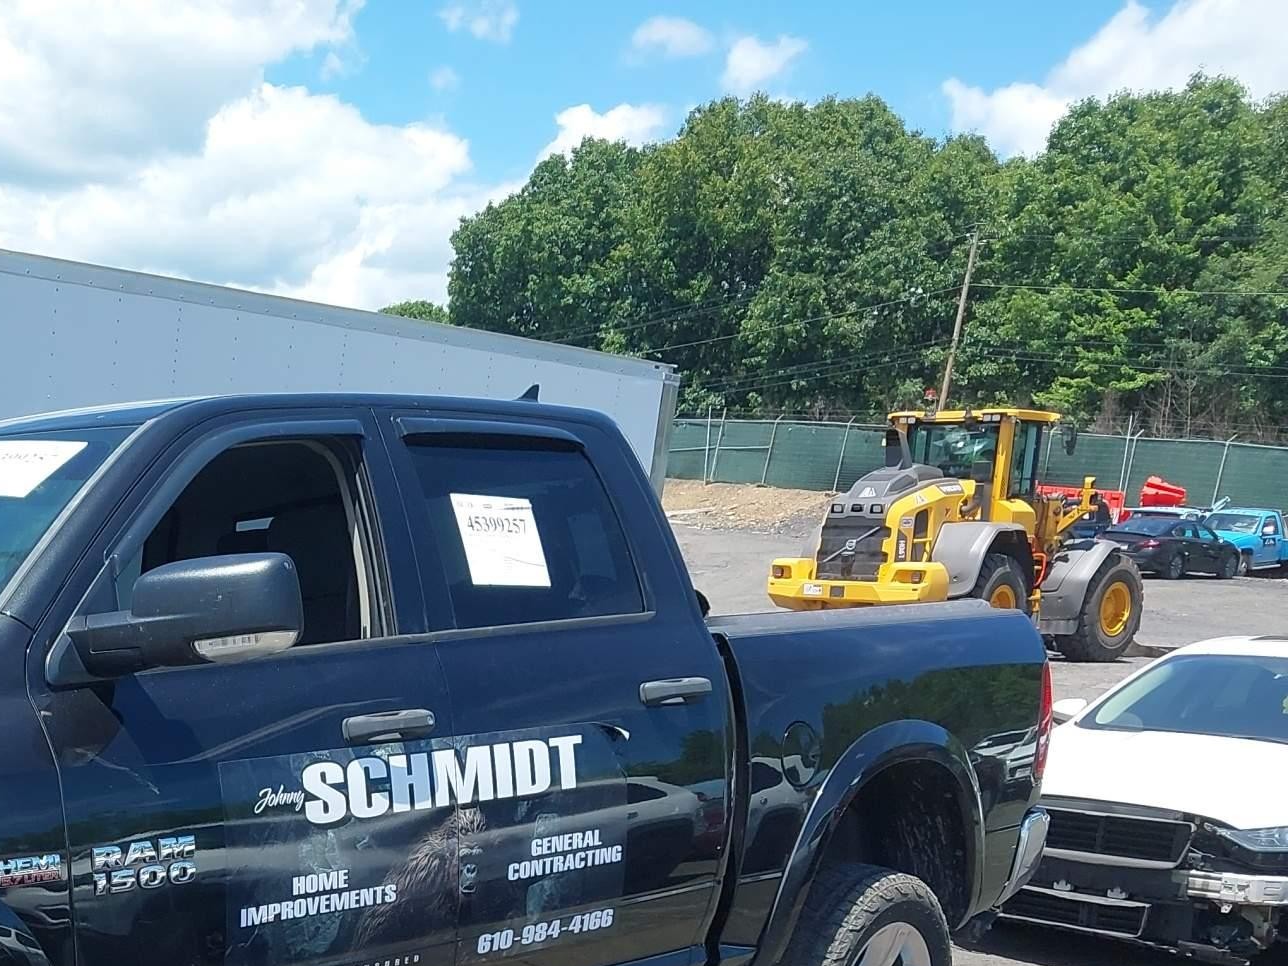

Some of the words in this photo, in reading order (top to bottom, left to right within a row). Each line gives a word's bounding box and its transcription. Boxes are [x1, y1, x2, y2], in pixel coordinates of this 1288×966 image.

[467, 516, 527, 534] 45399257
[254, 784, 305, 814] Johnny
[302, 735, 583, 825] SCHMIDT
[91, 835, 196, 870] RAM
[531, 829, 602, 857] GENERAL
[93, 860, 198, 896] 1500
[508, 845, 623, 881] CONTRACTING
[292, 869, 349, 896] HOME
[240, 884, 397, 928] IMPROVEMENTS
[477, 908, 614, 954] 610-984-4166
